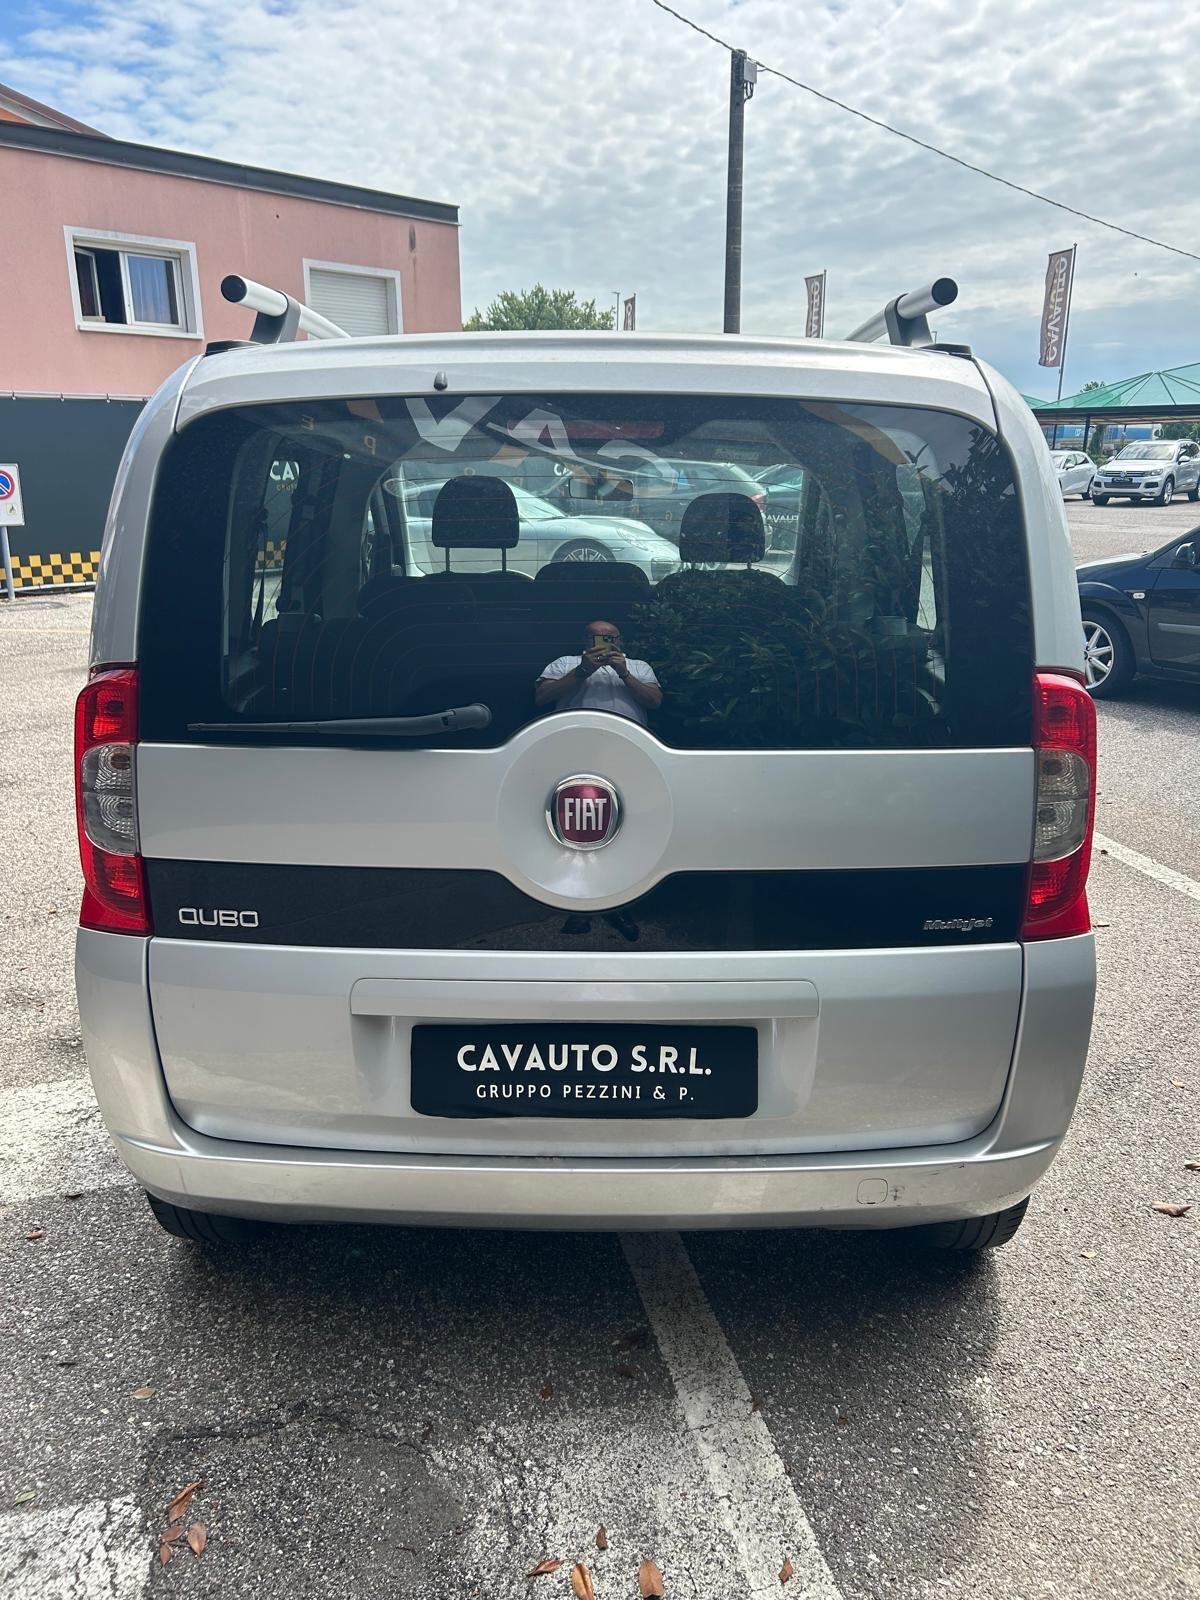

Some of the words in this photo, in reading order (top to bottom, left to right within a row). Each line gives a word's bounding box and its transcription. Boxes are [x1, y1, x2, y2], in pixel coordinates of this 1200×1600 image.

[564, 798, 607, 831] FIAT
[179, 908, 259, 927] QUBO
[457, 1044, 618, 1072] CAVAUTO
[630, 1045, 712, 1075] S.R.L.
[476, 1085, 551, 1098] GRUPPO
[563, 1085, 641, 1099] PEZZINI
[653, 1086, 666, 1100] &
[679, 1087, 695, 1101] P.
